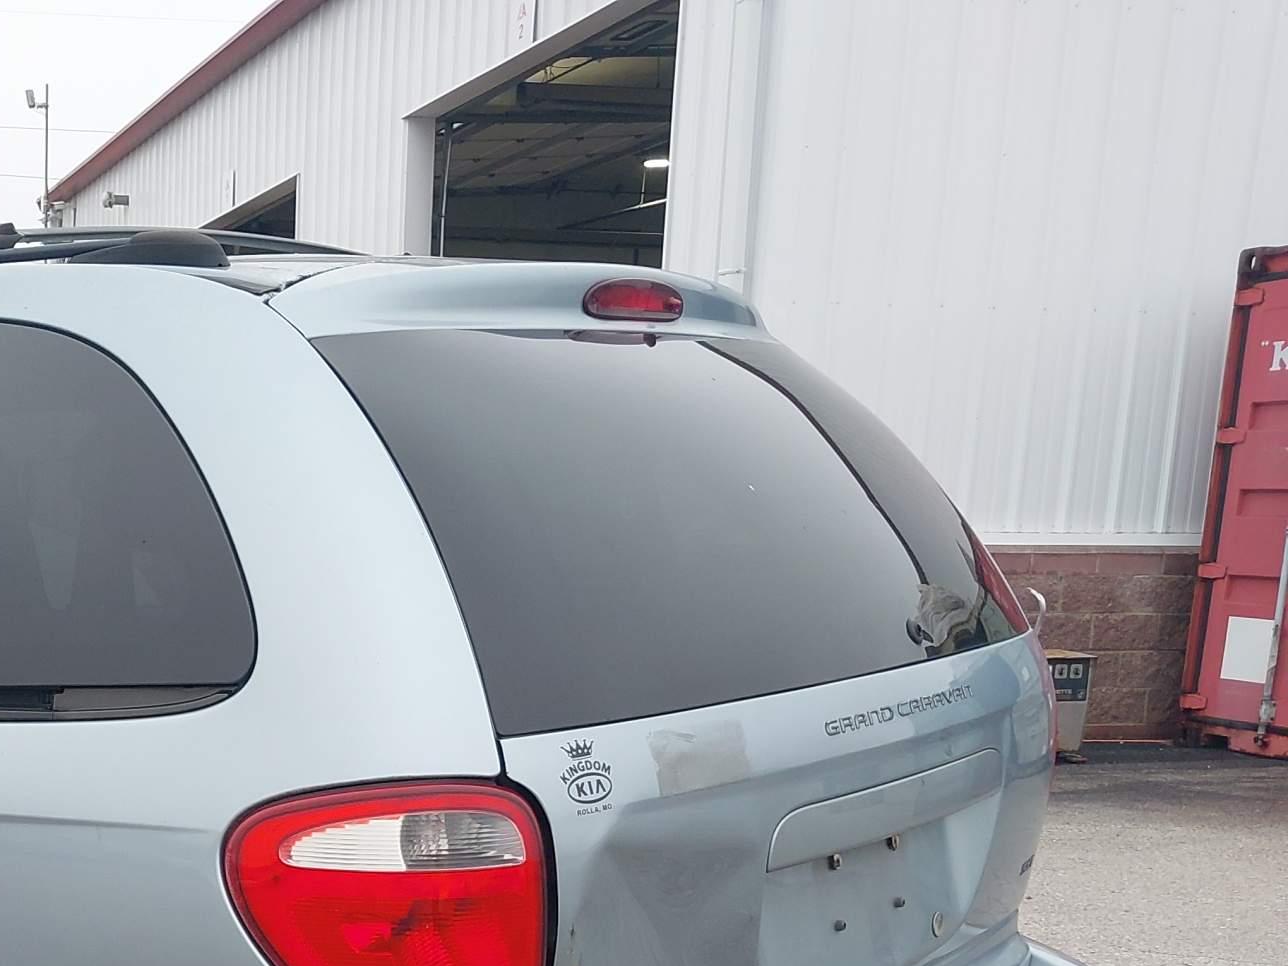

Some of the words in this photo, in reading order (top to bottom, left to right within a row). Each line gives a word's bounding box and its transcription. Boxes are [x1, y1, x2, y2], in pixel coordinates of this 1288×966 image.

[824, 706, 894, 737] GRAND
[897, 684, 974, 717] CARAVAN
[559, 760, 611, 785] KINGDOM
[575, 779, 607, 798] KIA
